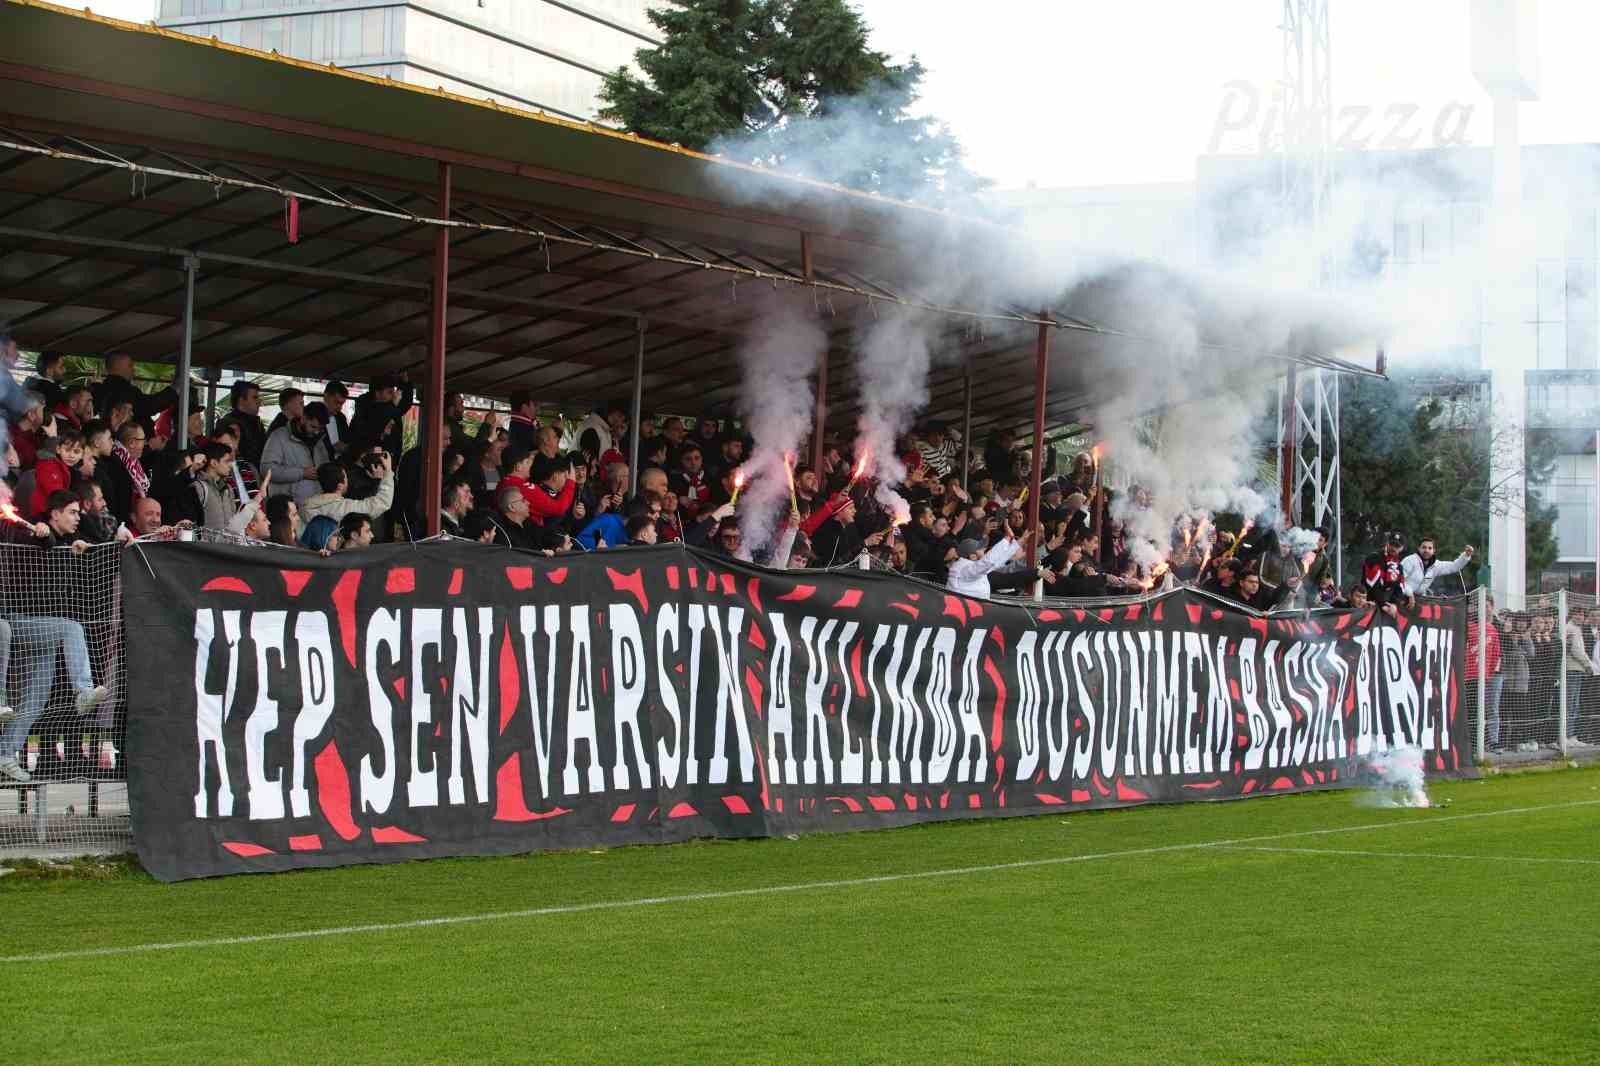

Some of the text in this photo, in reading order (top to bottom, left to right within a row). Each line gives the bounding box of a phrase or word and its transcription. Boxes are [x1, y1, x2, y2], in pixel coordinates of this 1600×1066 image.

[1206, 78, 1476, 154] Pizza
[194, 608, 336, 820] HEP
[360, 606, 494, 814] SEN
[519, 602, 756, 799] VARSIN
[768, 612, 988, 784] AKLIMDA
[1015, 630, 1234, 782] DUSUNMEM
